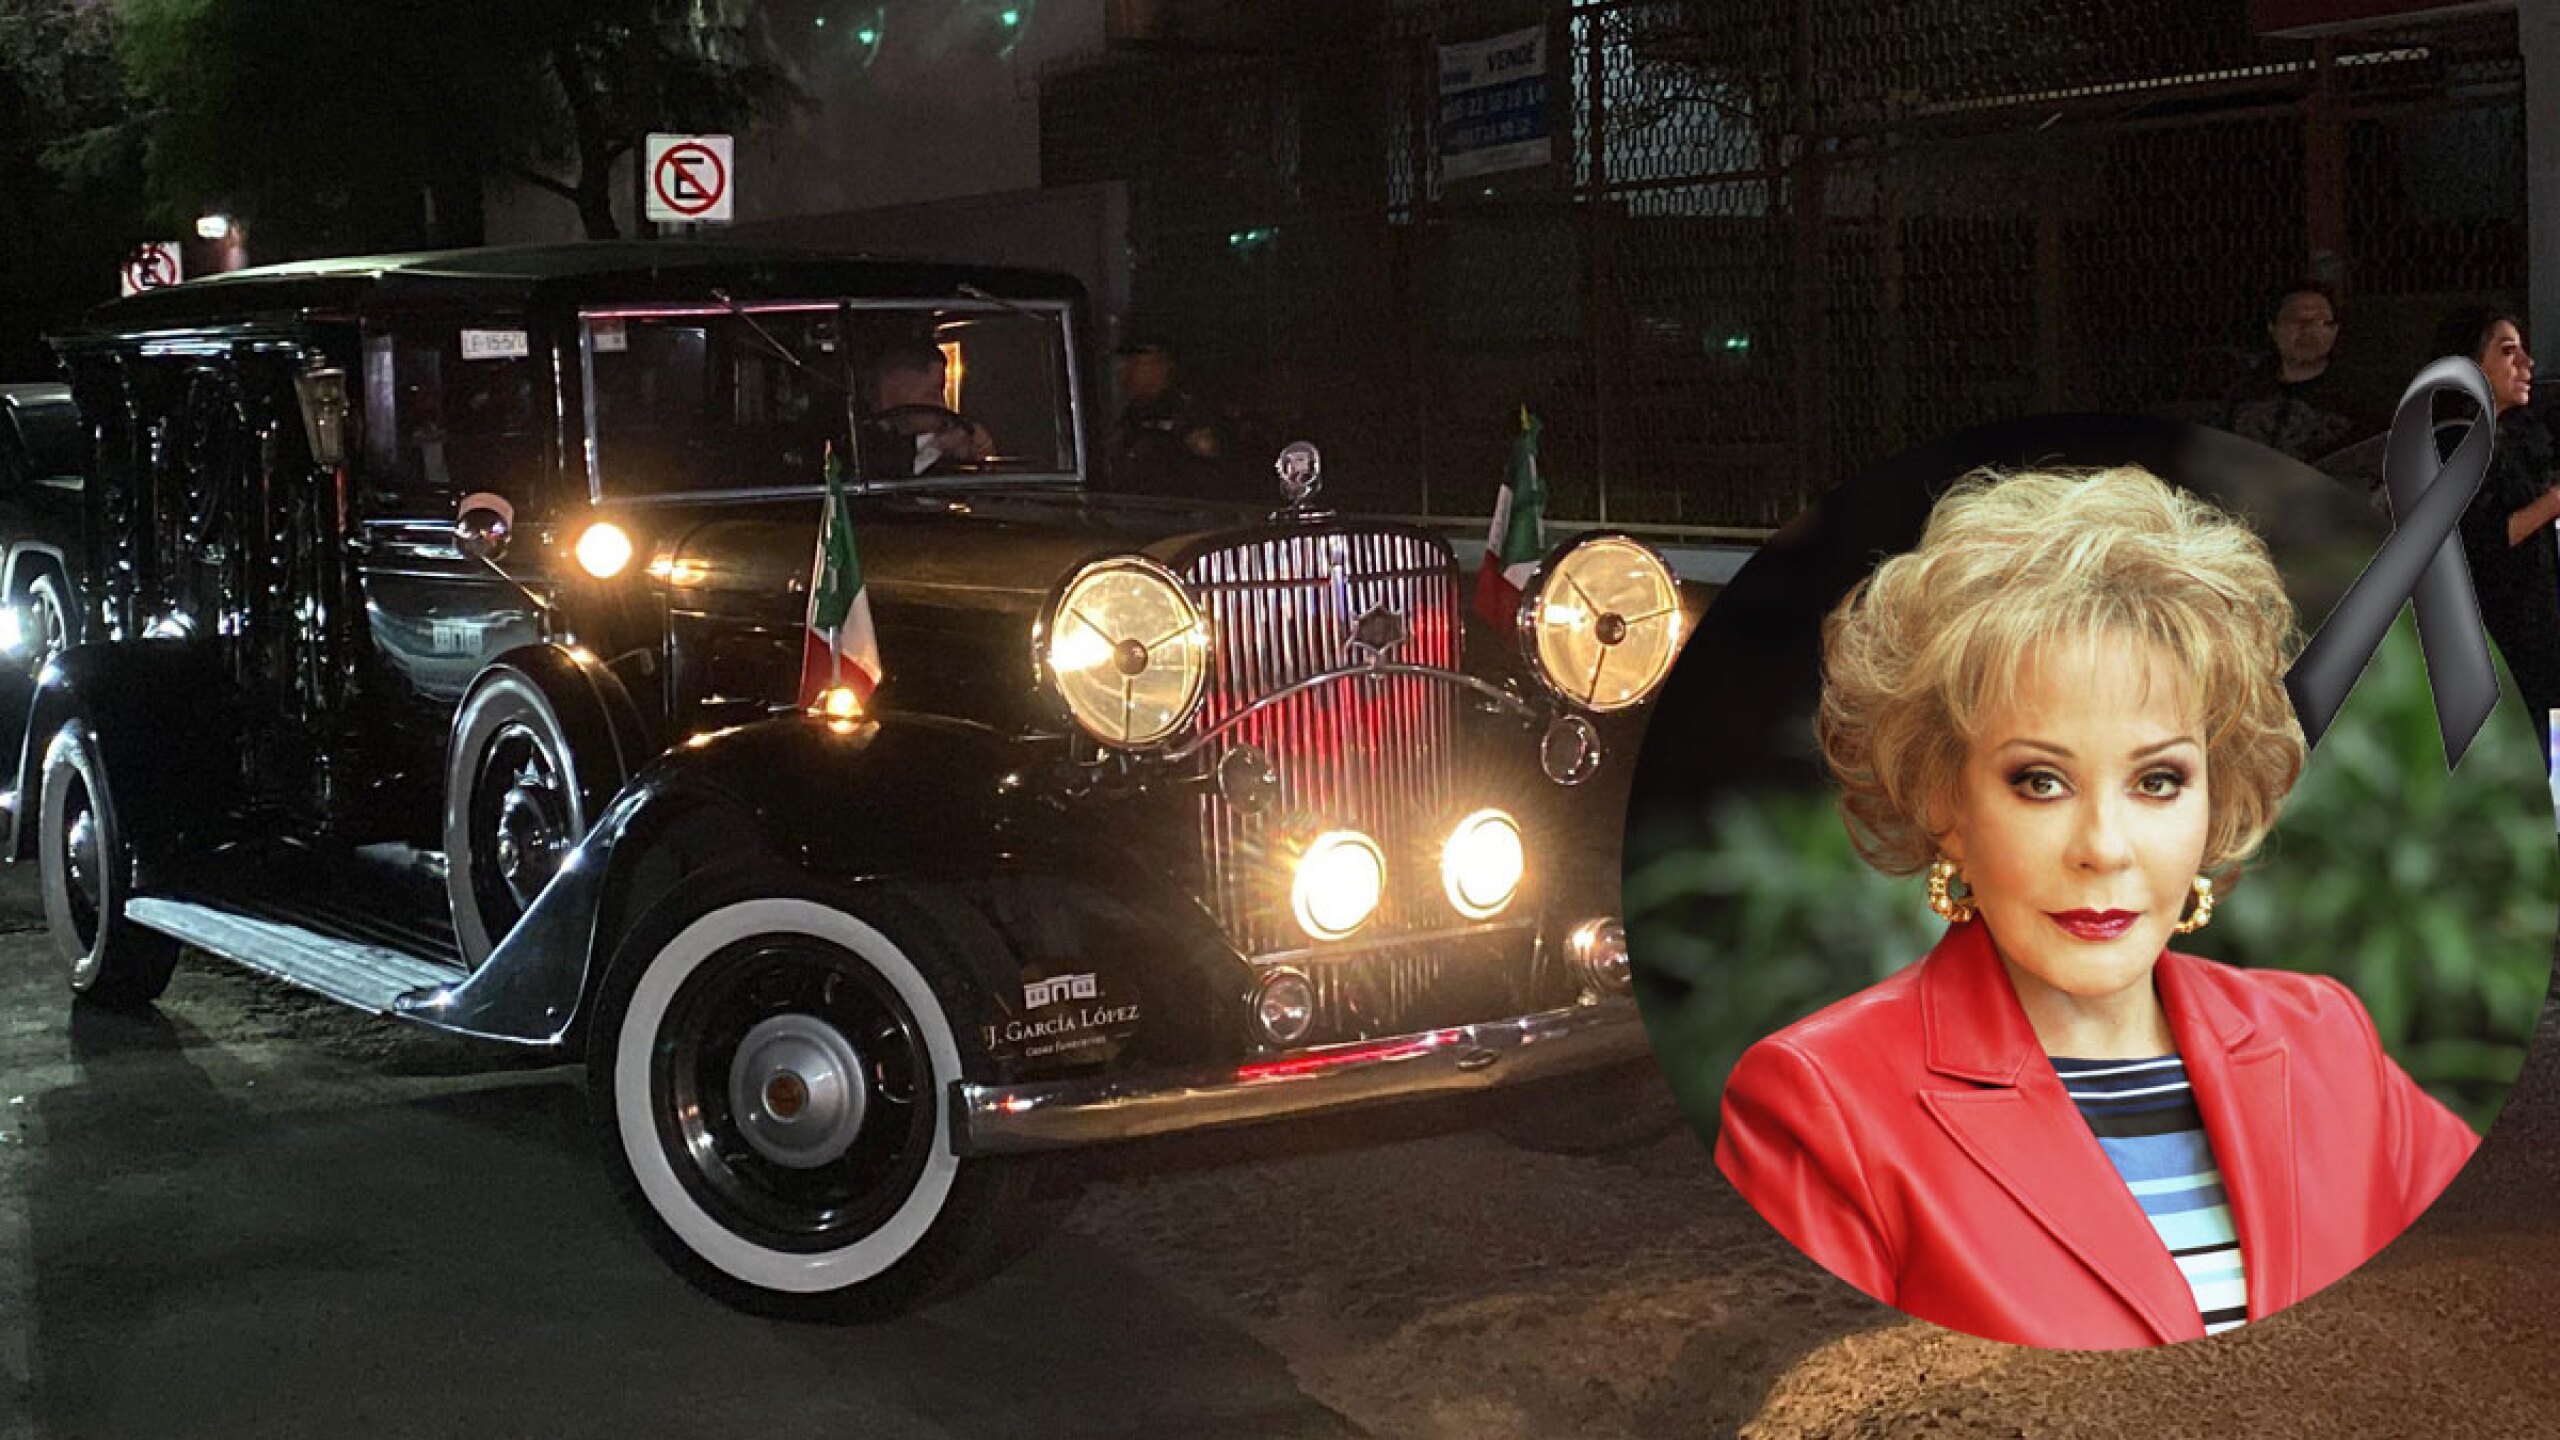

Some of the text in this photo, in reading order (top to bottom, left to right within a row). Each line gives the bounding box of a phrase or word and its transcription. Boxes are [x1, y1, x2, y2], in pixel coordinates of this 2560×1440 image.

[1486, 41, 1537, 72] VENDE
[674, 157, 708, 199] E
[987, 1025, 1004, 1050] J.
